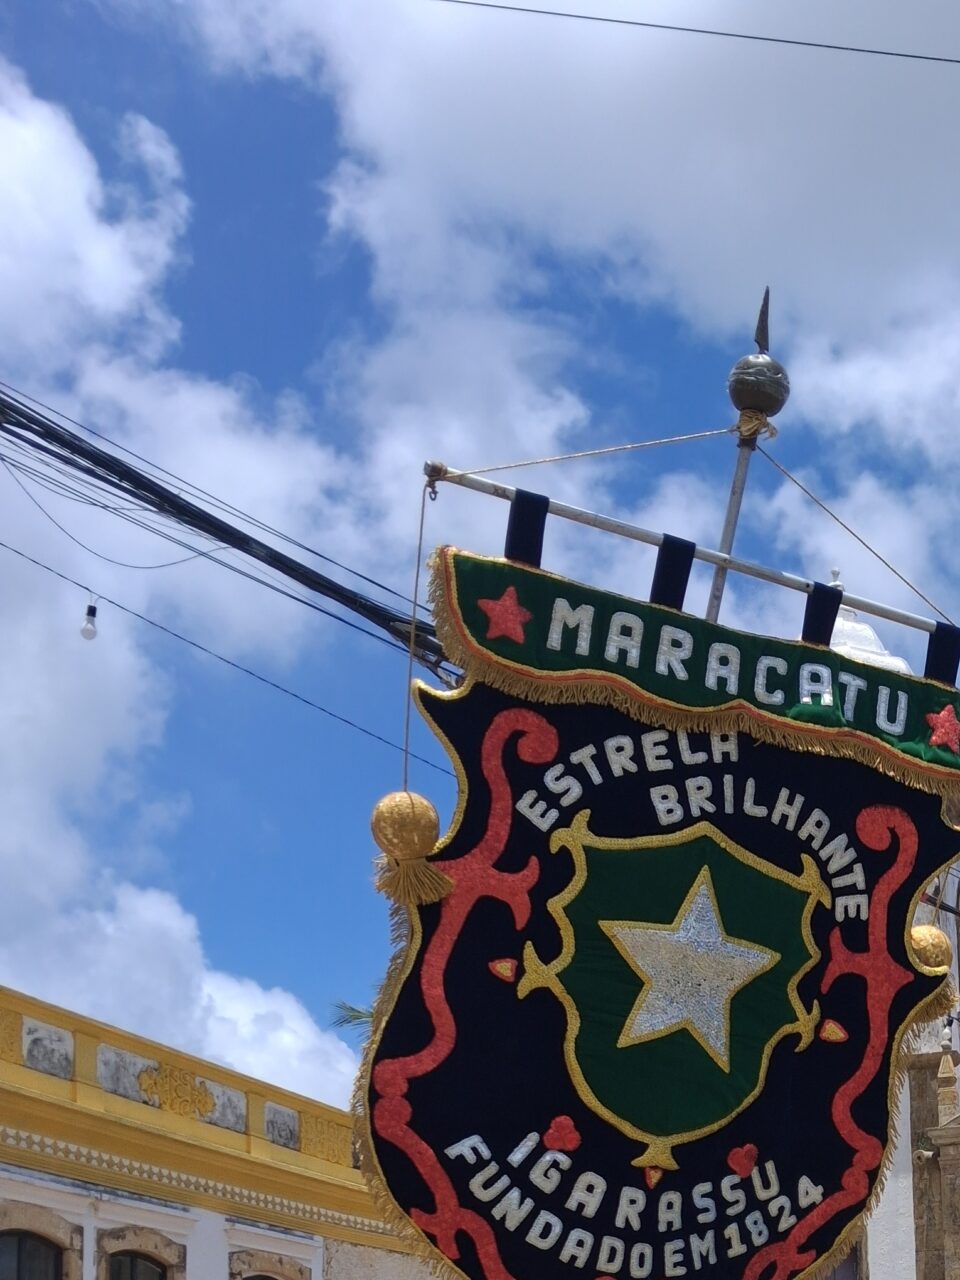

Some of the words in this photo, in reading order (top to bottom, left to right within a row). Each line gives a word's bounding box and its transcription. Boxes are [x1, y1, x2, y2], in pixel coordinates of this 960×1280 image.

[545, 596, 910, 737] MARACATU
[514, 728, 740, 833] ESTRELA
[649, 773, 870, 923] BRILHANTE
[443, 1134, 654, 1279] FUNDADO
[723, 1174, 825, 1259] 1824
[506, 1131, 781, 1233] IGARASSU
